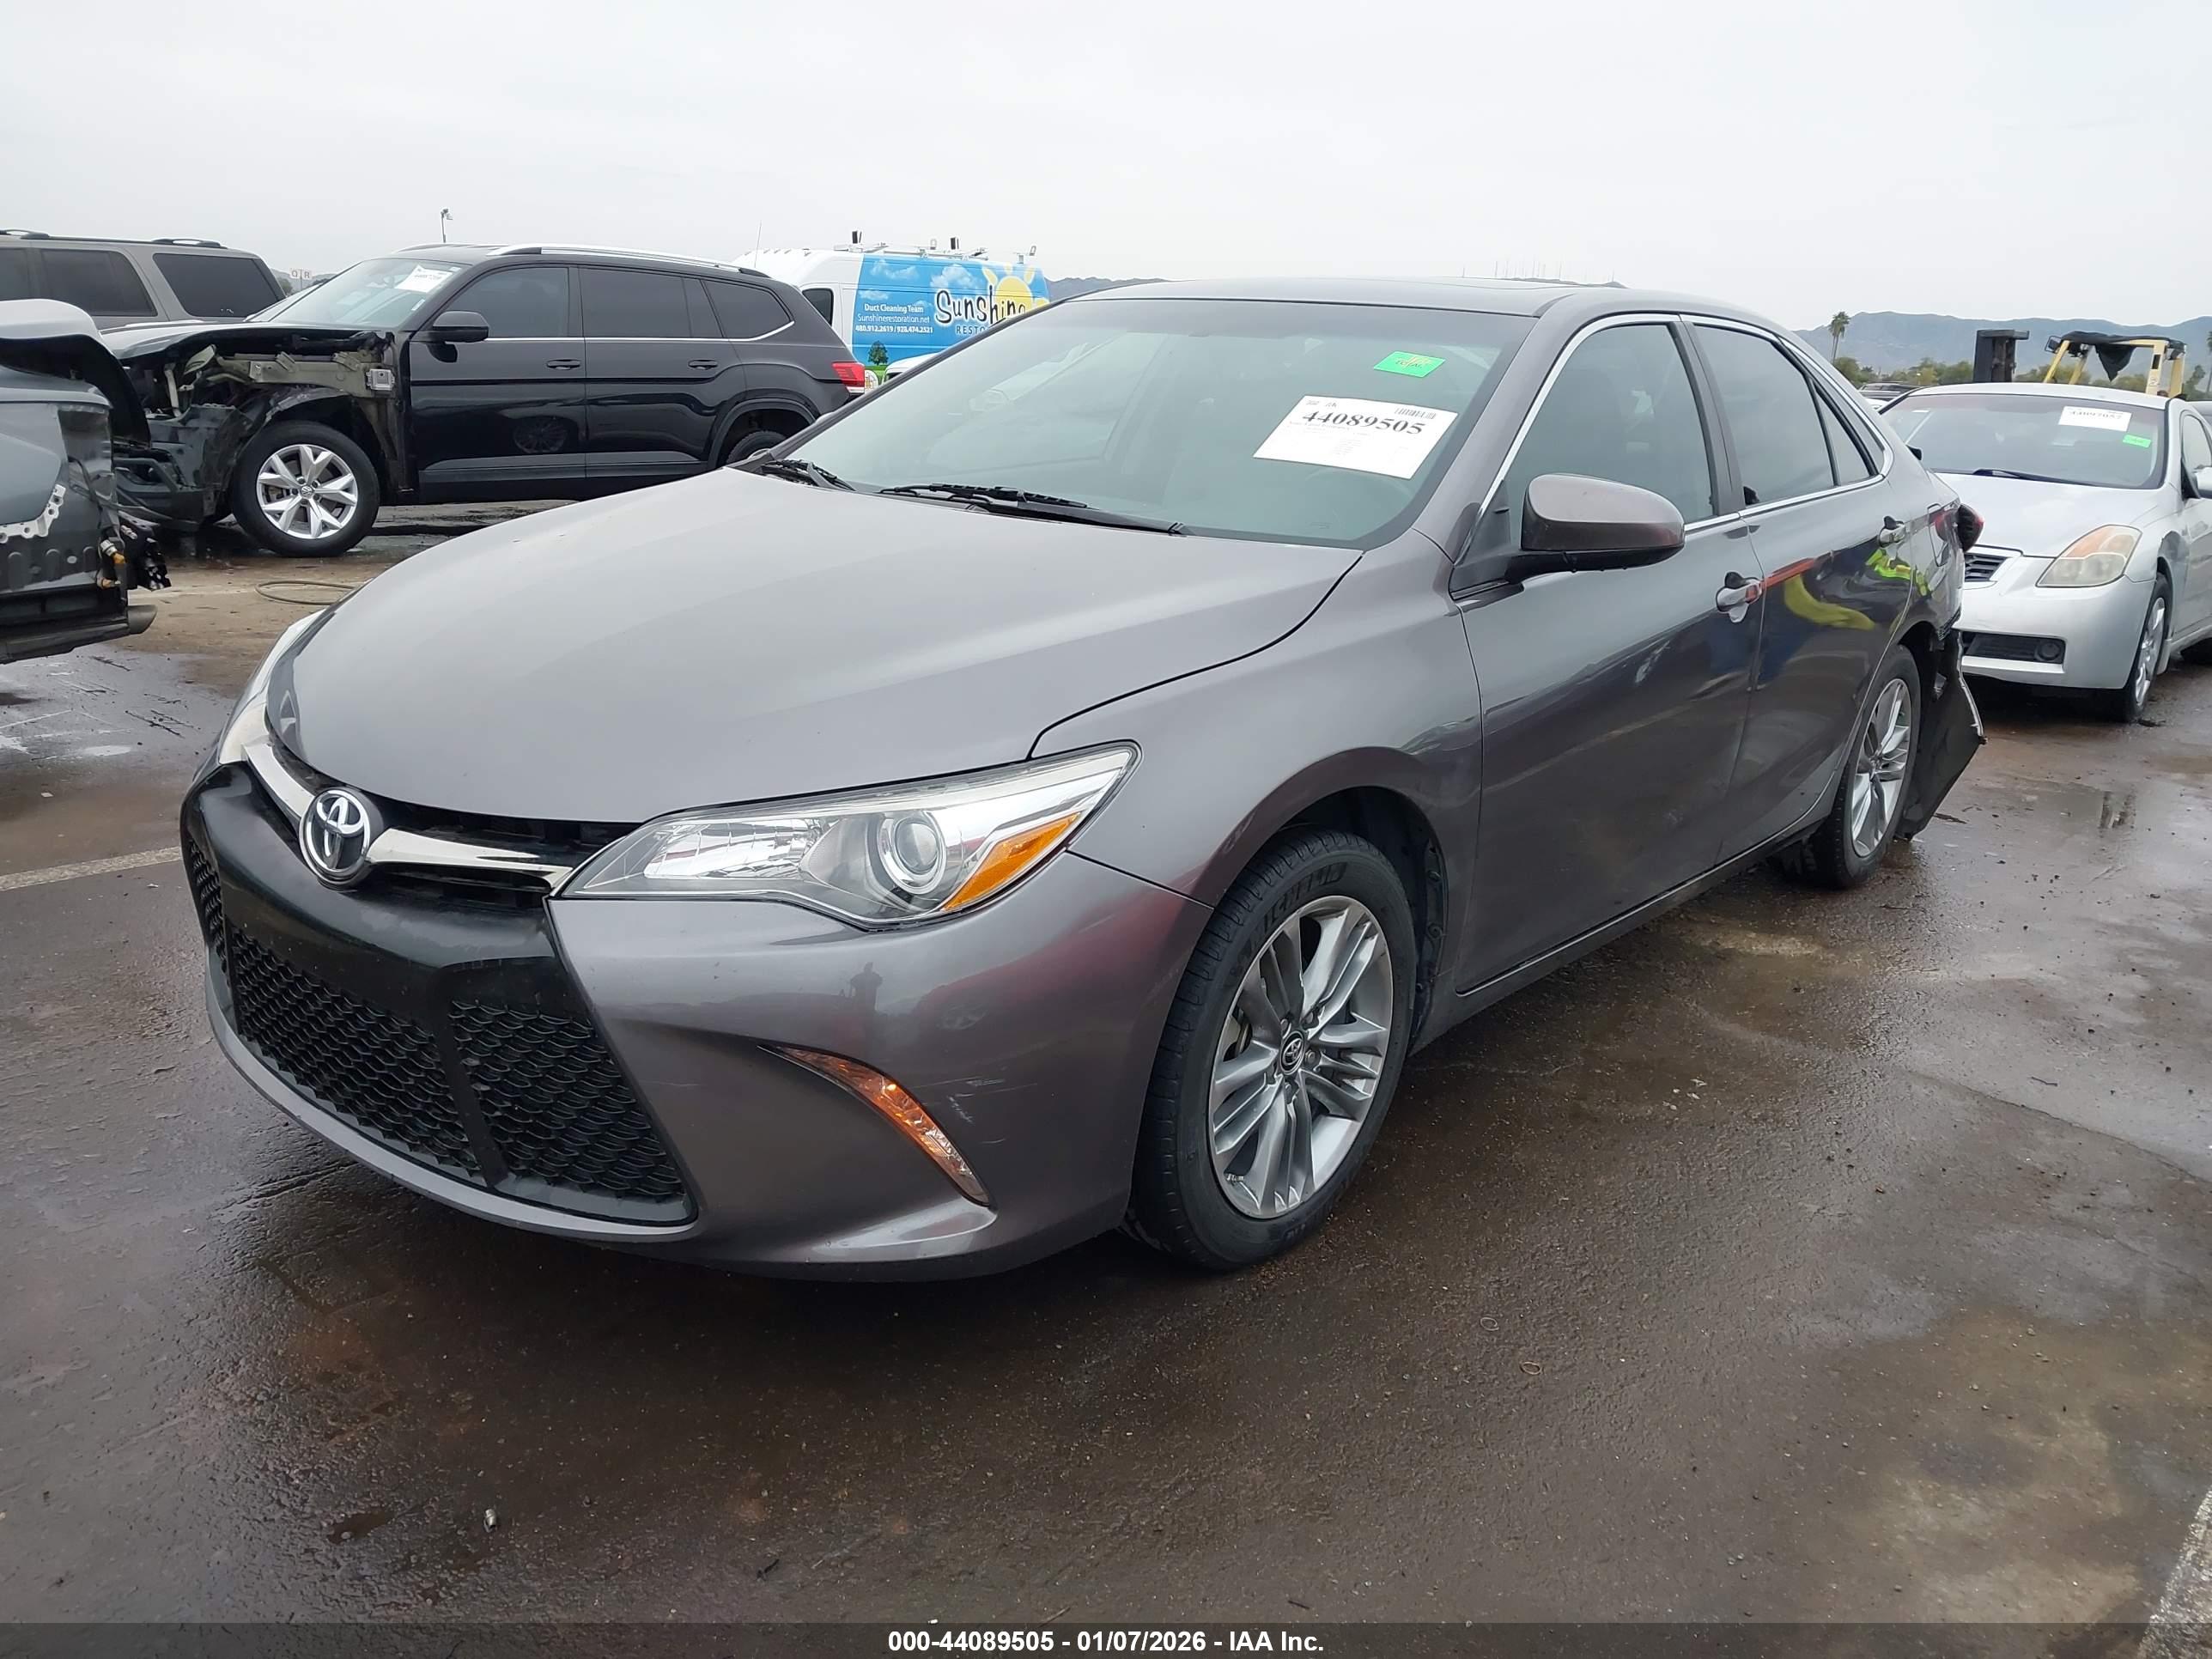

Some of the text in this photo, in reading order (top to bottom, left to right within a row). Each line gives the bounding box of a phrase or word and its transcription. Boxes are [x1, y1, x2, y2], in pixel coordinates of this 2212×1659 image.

[864, 303, 879, 312] Duct
[880, 303, 907, 314] Cleaning
[857, 313, 930, 324] Sunshinerestoration.net
[1302, 410, 1426, 435] 44089505
